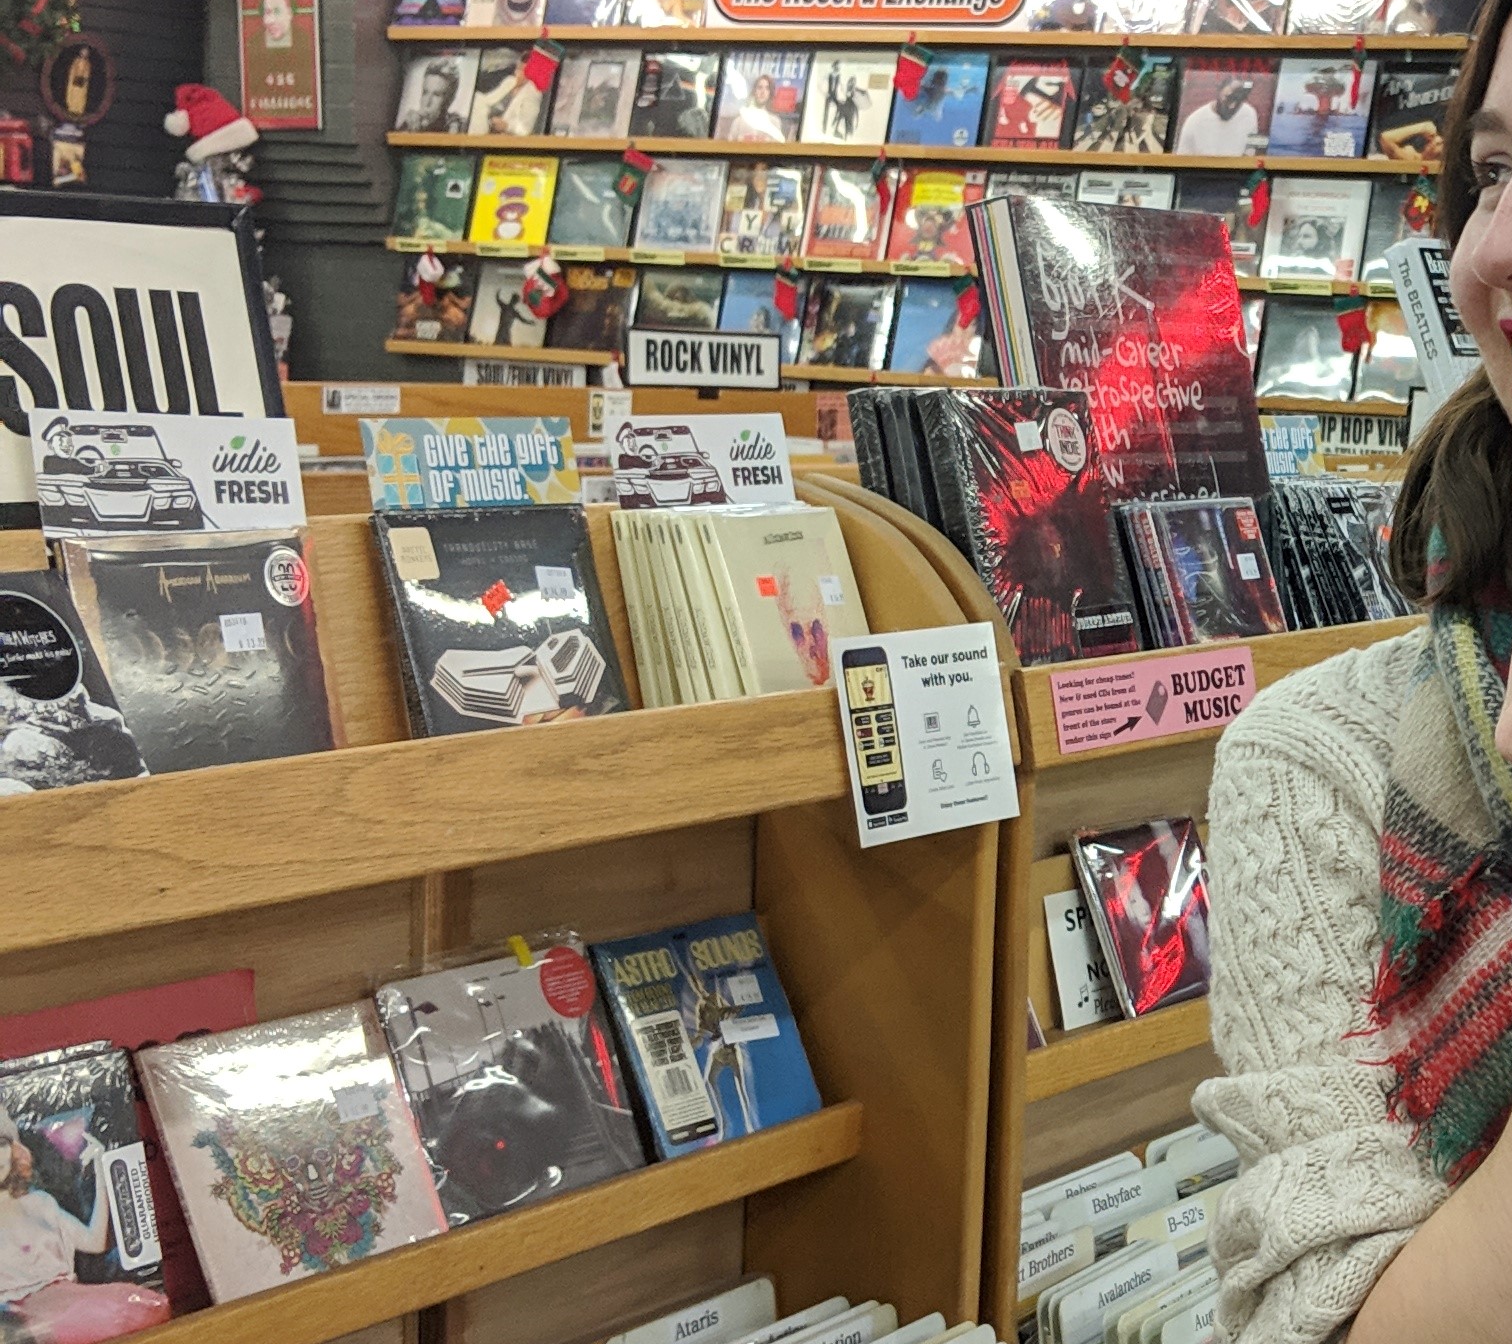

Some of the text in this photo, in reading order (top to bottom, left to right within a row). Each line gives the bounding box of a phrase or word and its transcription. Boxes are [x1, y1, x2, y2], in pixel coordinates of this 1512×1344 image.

[1398, 257, 1438, 361] The BEATLES
[0, 282, 244, 438] SOUL
[645, 338, 765, 376] ROCK VINYL
[1060, 325, 1183, 371] mid-career
[1060, 371, 1205, 422] retrospective
[729, 431, 776, 462] indie
[1054, 422, 1077, 442] THINK
[1340, 415, 1375, 446] HOP
[212, 439, 282, 474] indie
[1059, 439, 1081, 456] INDIE
[214, 479, 290, 505] FRESH
[732, 465, 783, 487] FRESH
[901, 646, 988, 670] Take our sound
[921, 672, 974, 688] with you.
[1171, 664, 1246, 696] BUDGET
[1084, 706, 1095, 714] can
[1096, 703, 1103, 712] be
[1104, 701, 1123, 711] found
[1131, 697, 1142, 707] the
[1184, 694, 1242, 724] MUSIC
[1063, 716, 1117, 732] front of the store
[1064, 731, 1112, 746] under this sign
[614, 947, 678, 988] ASTRO
[130, 1167, 151, 1240] GUARANTEED
[1091, 1182, 1142, 1216] Babyface
[1029, 1242, 1075, 1277] Brothers
[1097, 1267, 1152, 1310] Avalanches
[674, 1308, 720, 1341] Ataris
